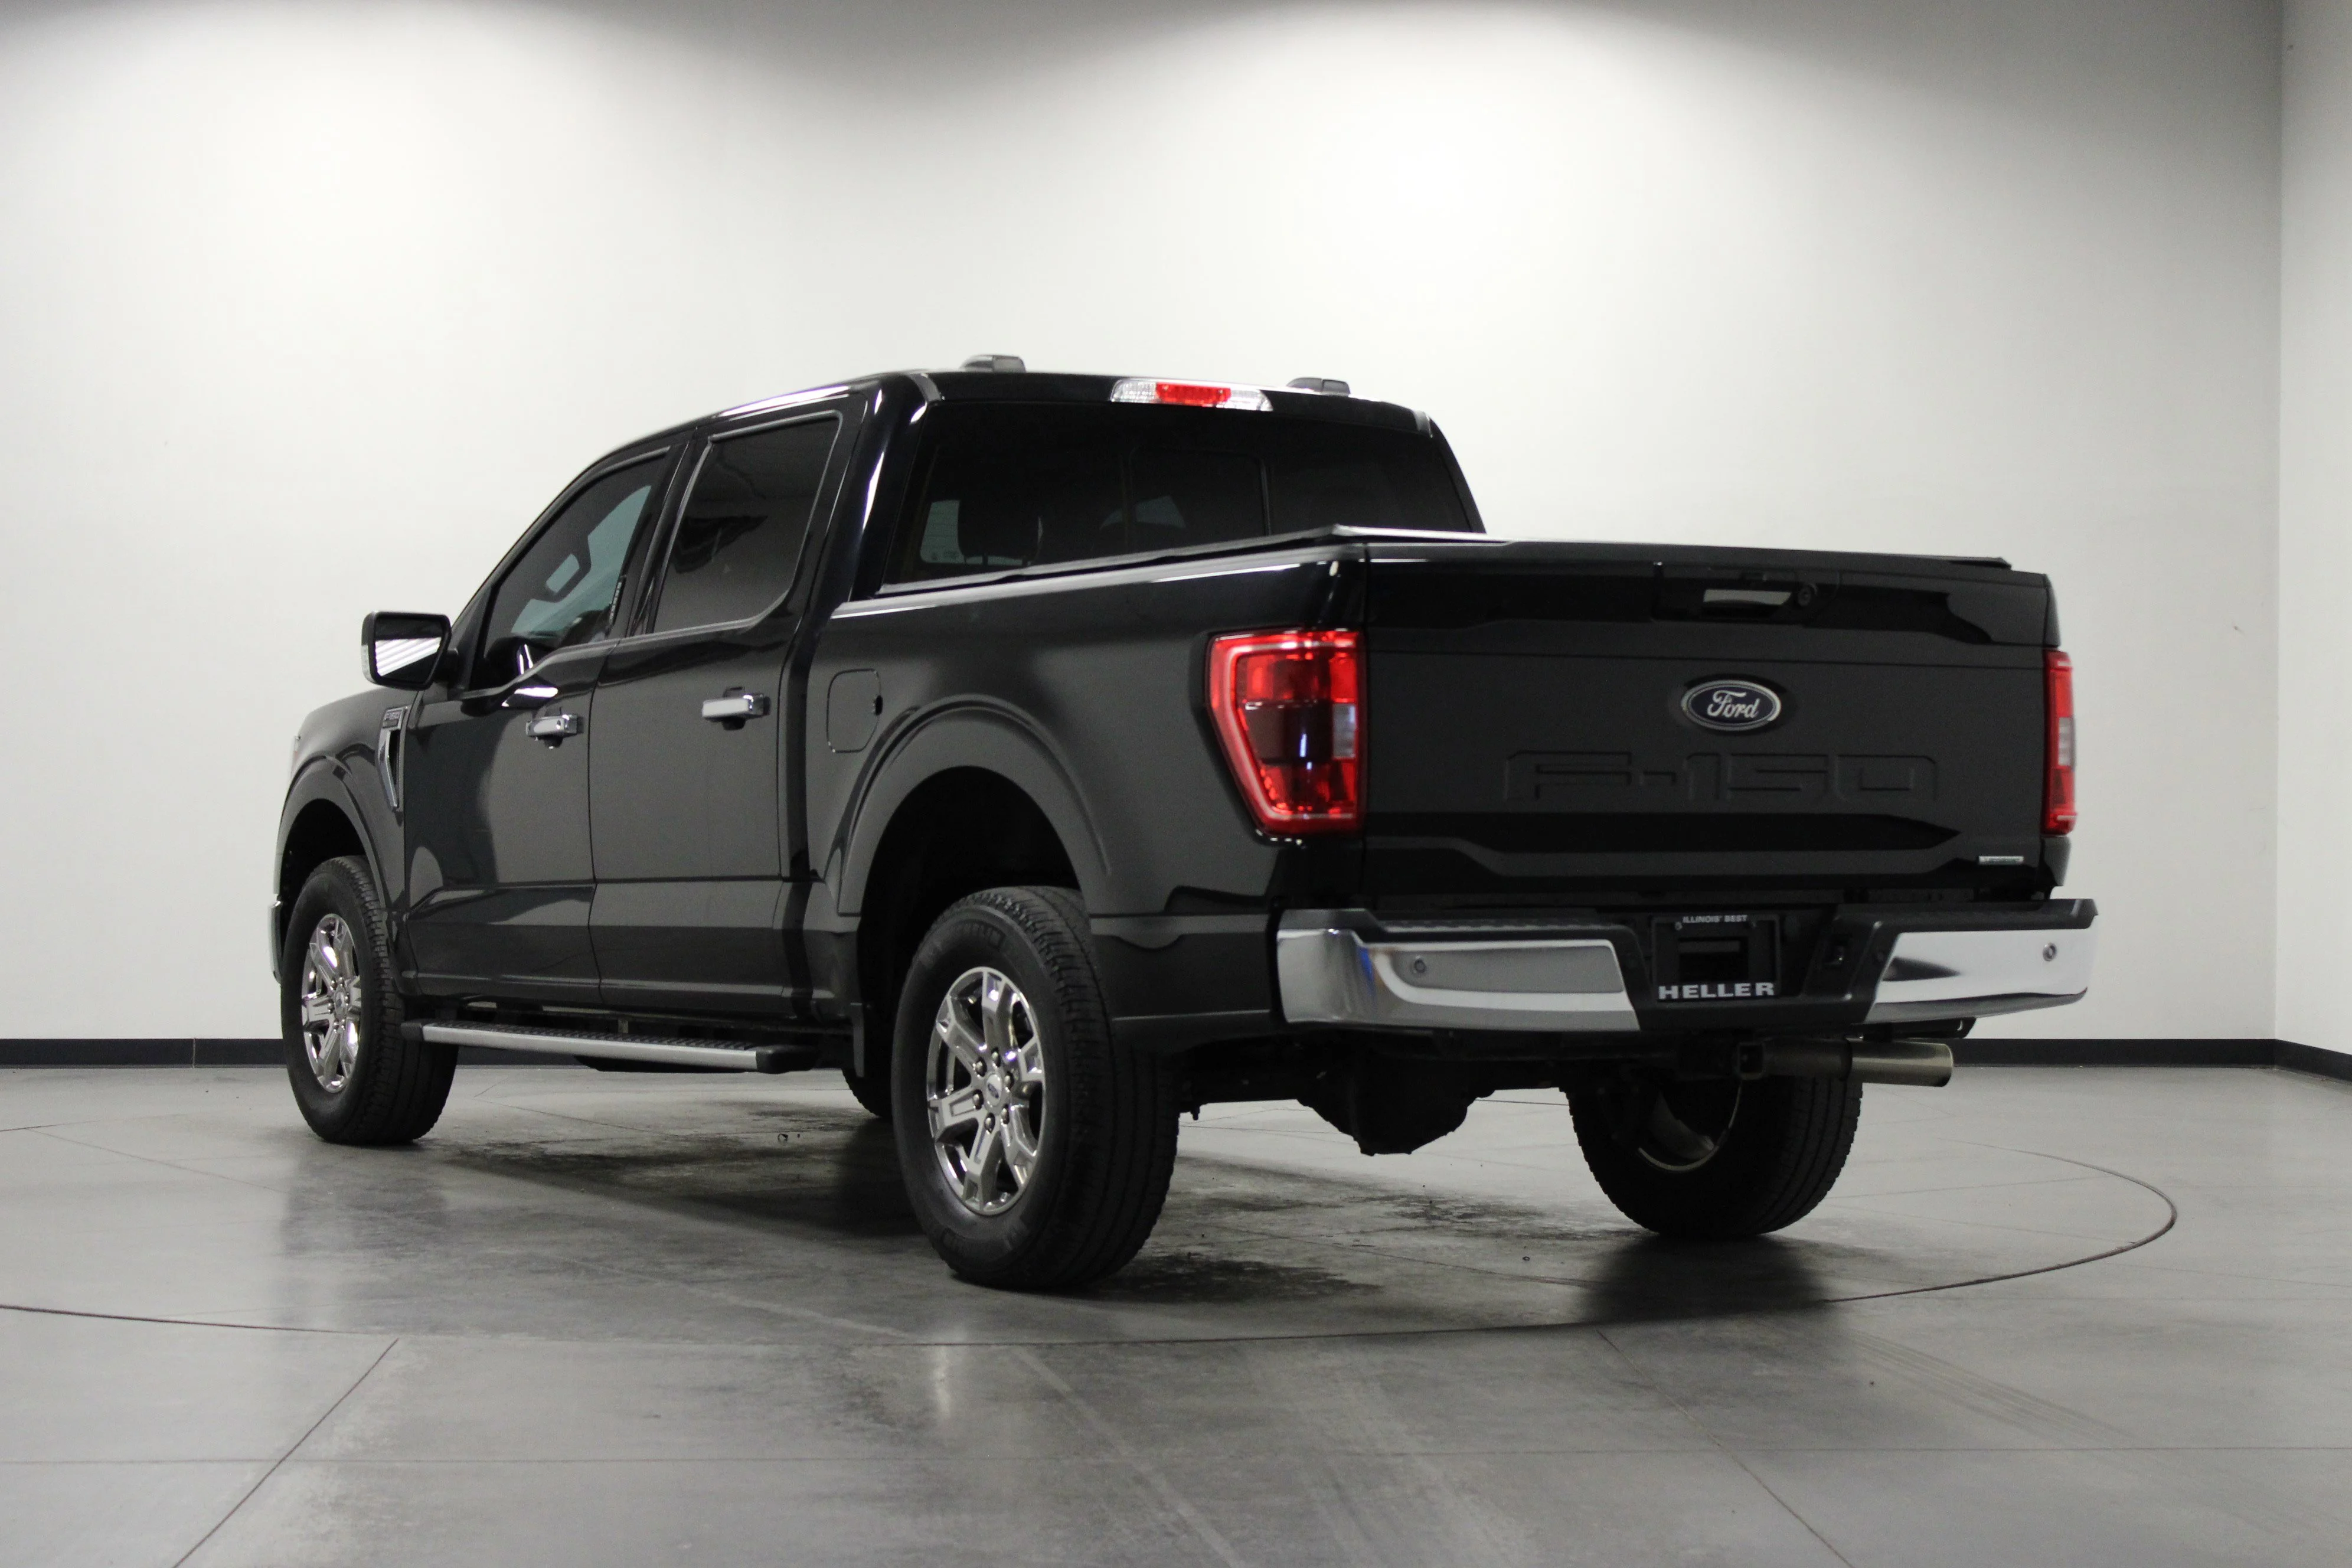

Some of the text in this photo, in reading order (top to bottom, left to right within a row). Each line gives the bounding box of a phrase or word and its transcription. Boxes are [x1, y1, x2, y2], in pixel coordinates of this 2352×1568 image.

[1707, 690, 1760, 718] Ford
[1504, 750, 1938, 803] F-150
[1724, 914, 1748, 923] BEST
[1658, 982, 1775, 1000] HELLER
